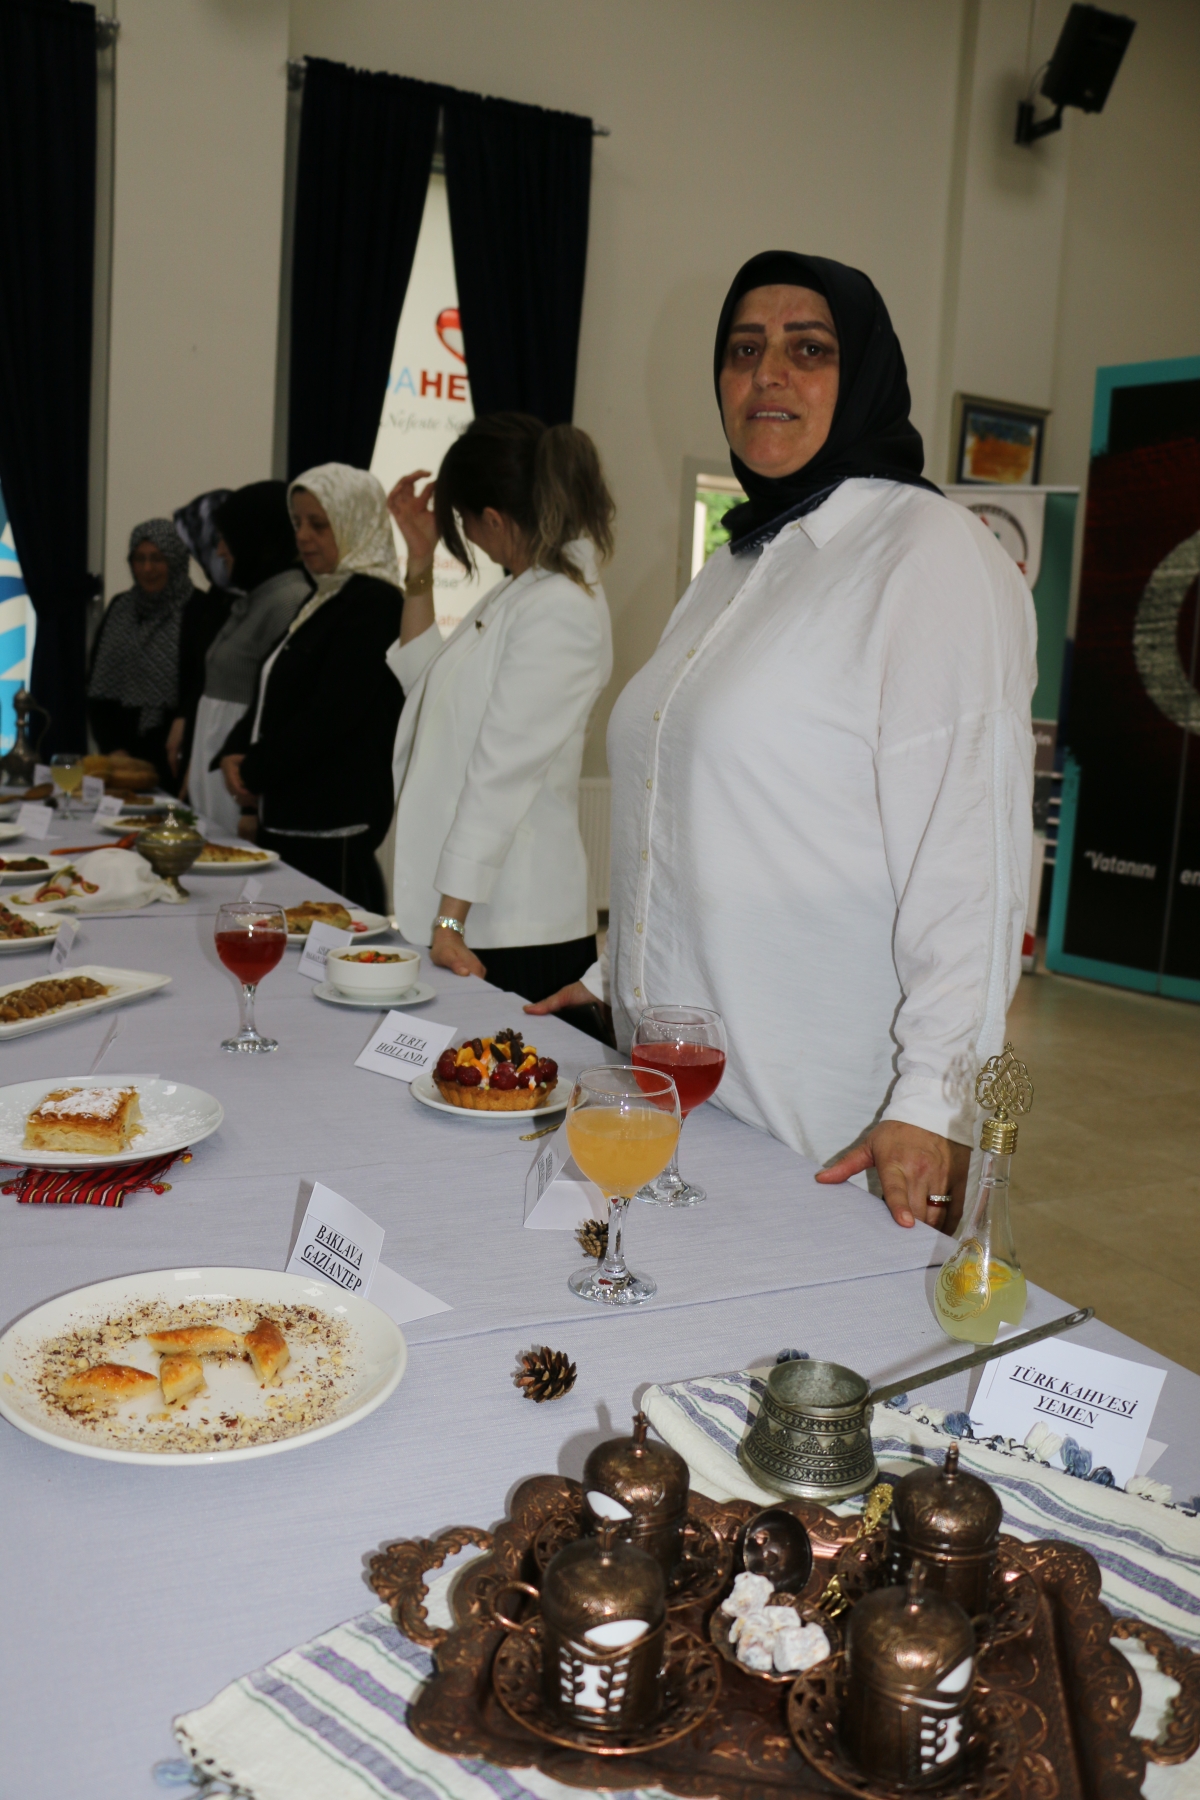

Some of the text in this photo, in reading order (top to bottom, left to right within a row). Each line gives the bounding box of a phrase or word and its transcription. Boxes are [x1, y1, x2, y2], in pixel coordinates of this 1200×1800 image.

[387, 366, 468, 402] AHE
[376, 1042, 429, 1065] HOLLANDA
[396, 1033, 427, 1050] TURTA
[316, 1225, 363, 1267] BAKLAVA
[303, 1244, 362, 1291] GAZİANTEP
[1012, 1365, 1138, 1415] TÜRK KAHVESİ
[1036, 1395, 1100, 1424] YEMEN
